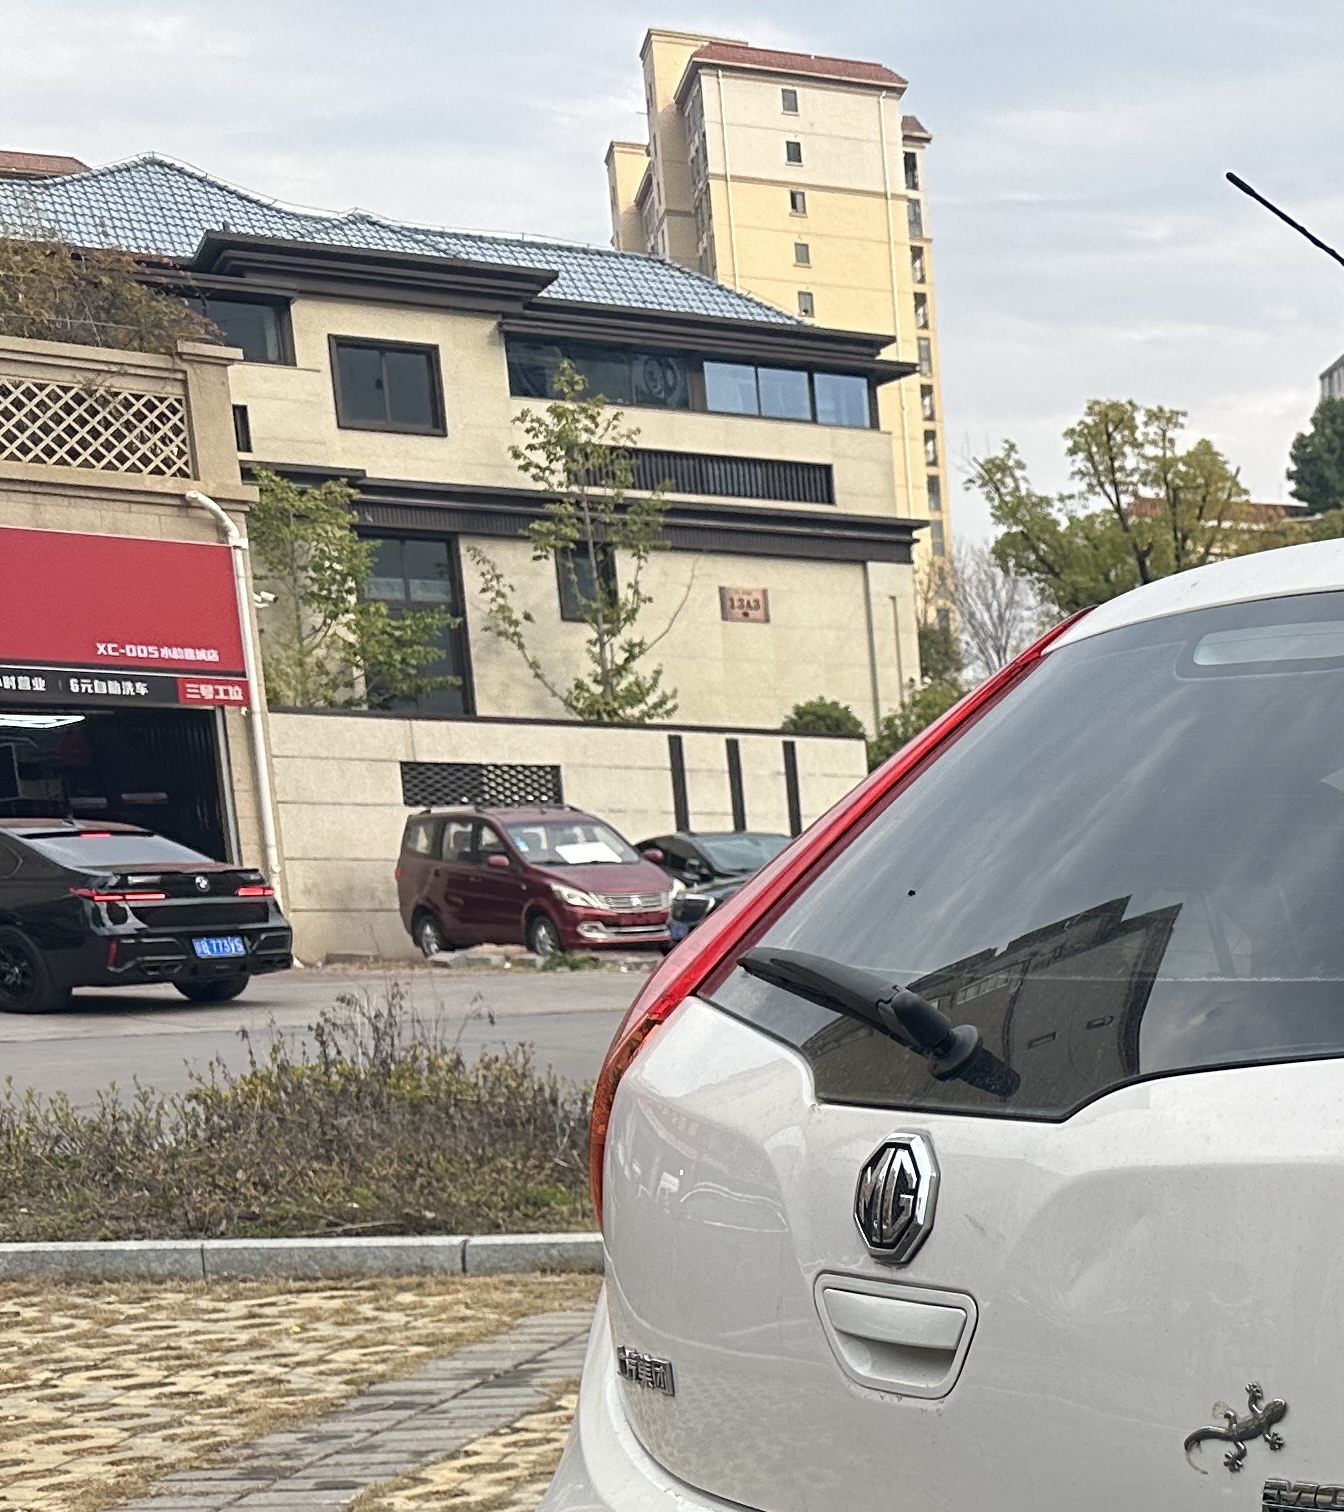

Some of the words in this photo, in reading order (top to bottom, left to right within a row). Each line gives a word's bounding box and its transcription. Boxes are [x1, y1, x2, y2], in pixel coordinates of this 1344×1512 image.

[0, 675, 46, 691] 时营业
[185, 684, 244, 700] 三号工位
